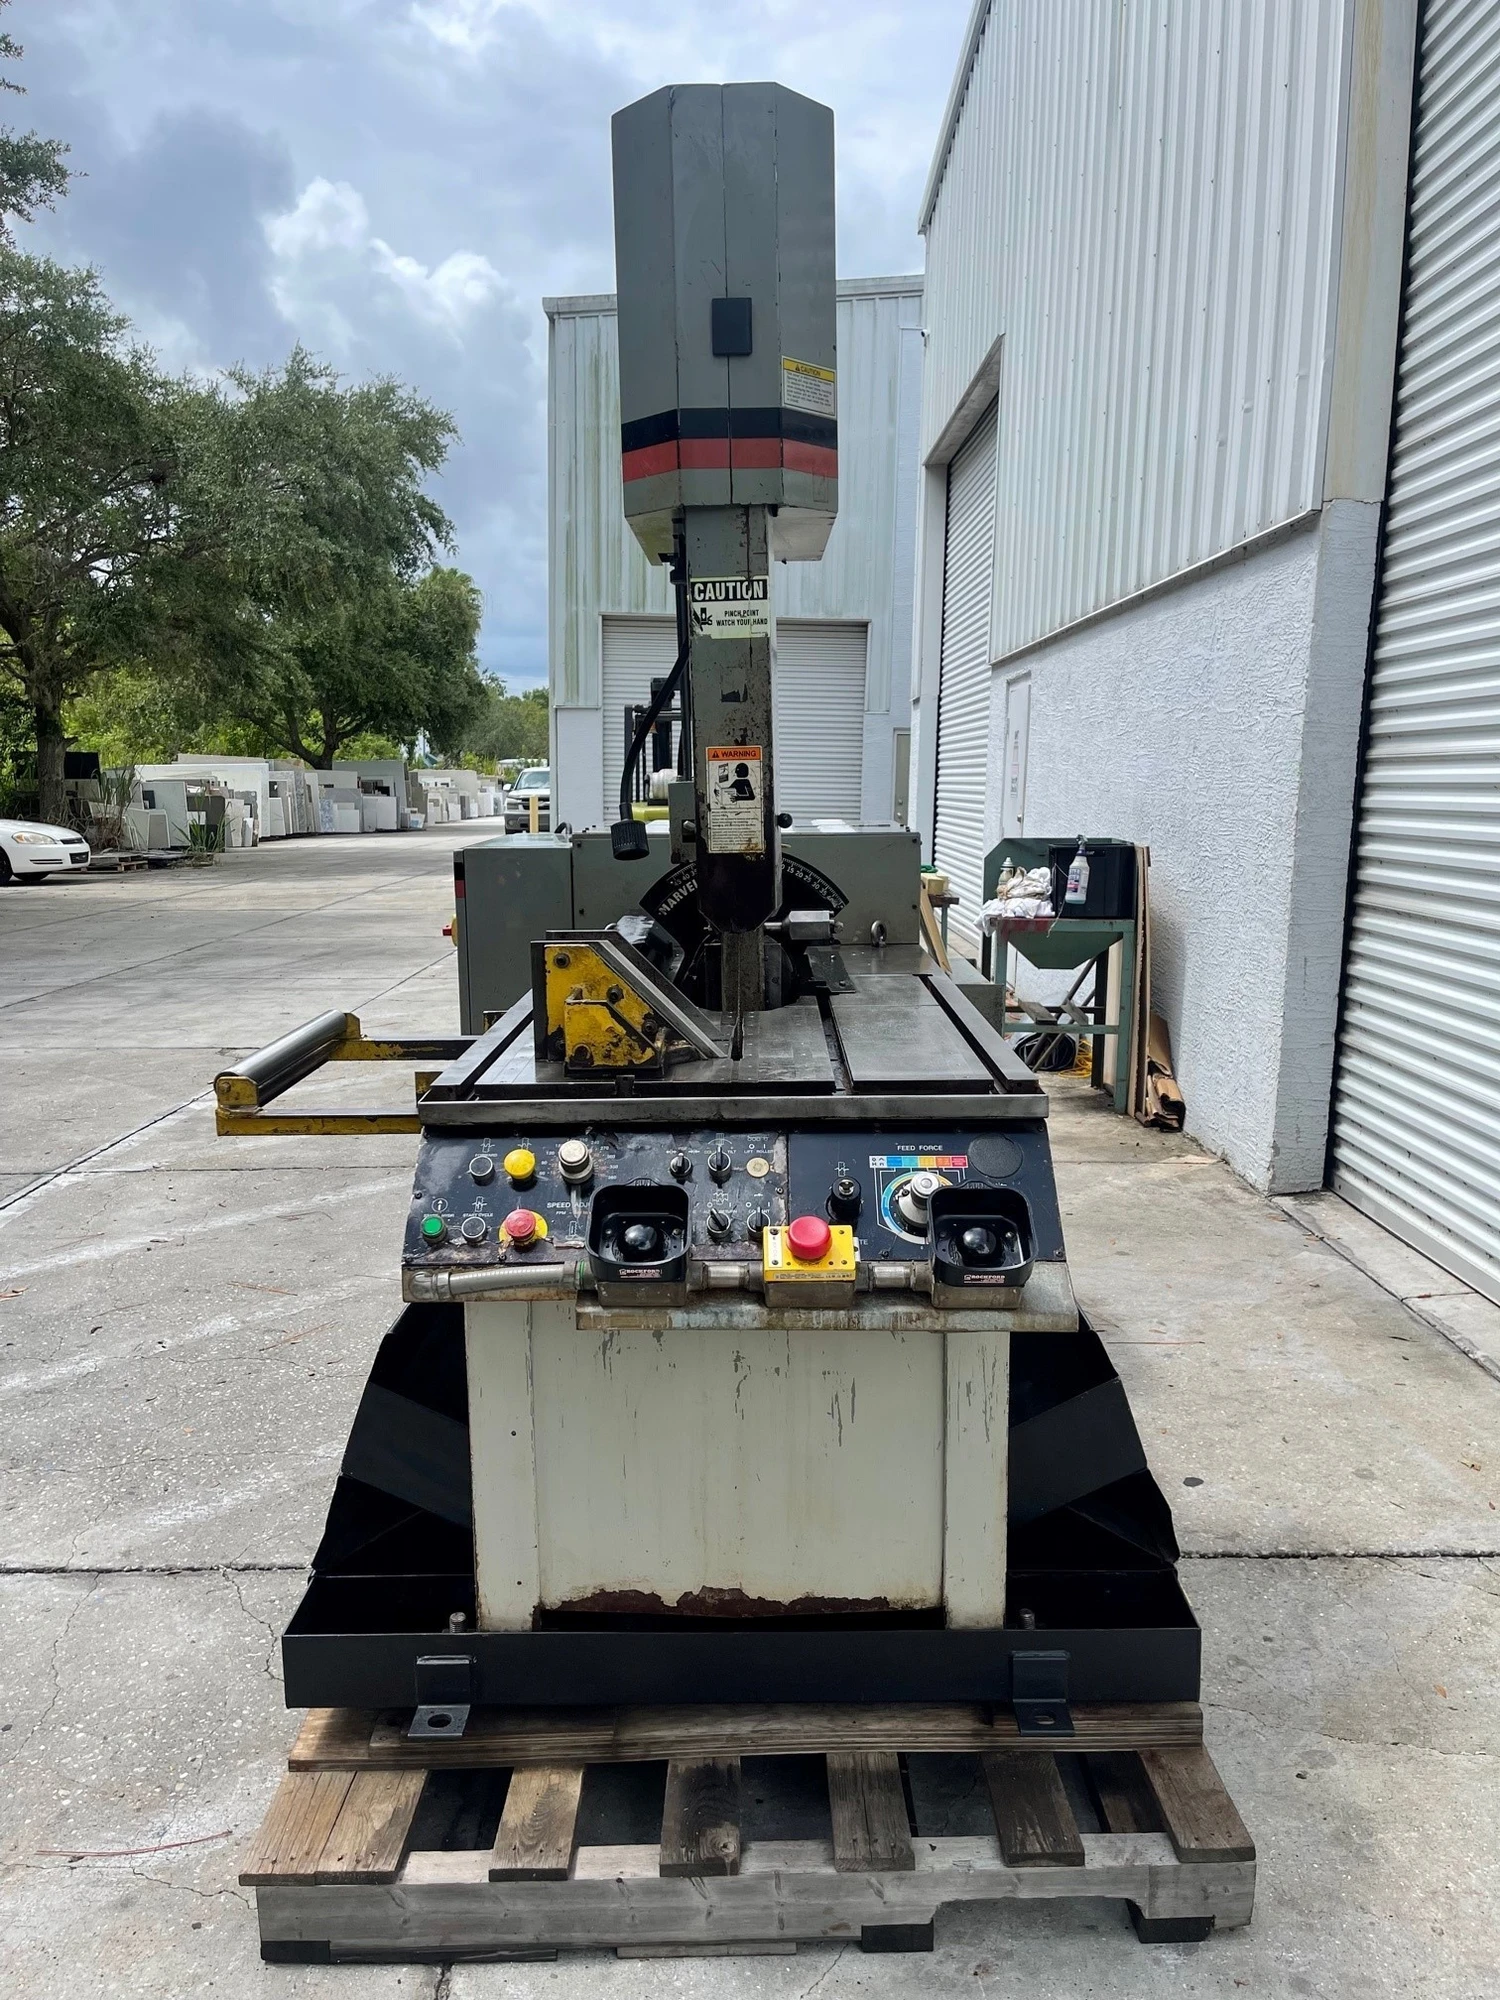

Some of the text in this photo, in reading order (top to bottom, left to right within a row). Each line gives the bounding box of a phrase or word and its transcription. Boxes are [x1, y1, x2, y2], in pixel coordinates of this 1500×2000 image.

[800, 365, 821, 376] CAUTION
[693, 580, 764, 601] CAUTION
[721, 750, 757, 758] WARNING
[787, 866, 795, 874] 15
[795, 870, 804, 878] 20
[803, 875, 812, 883] 25
